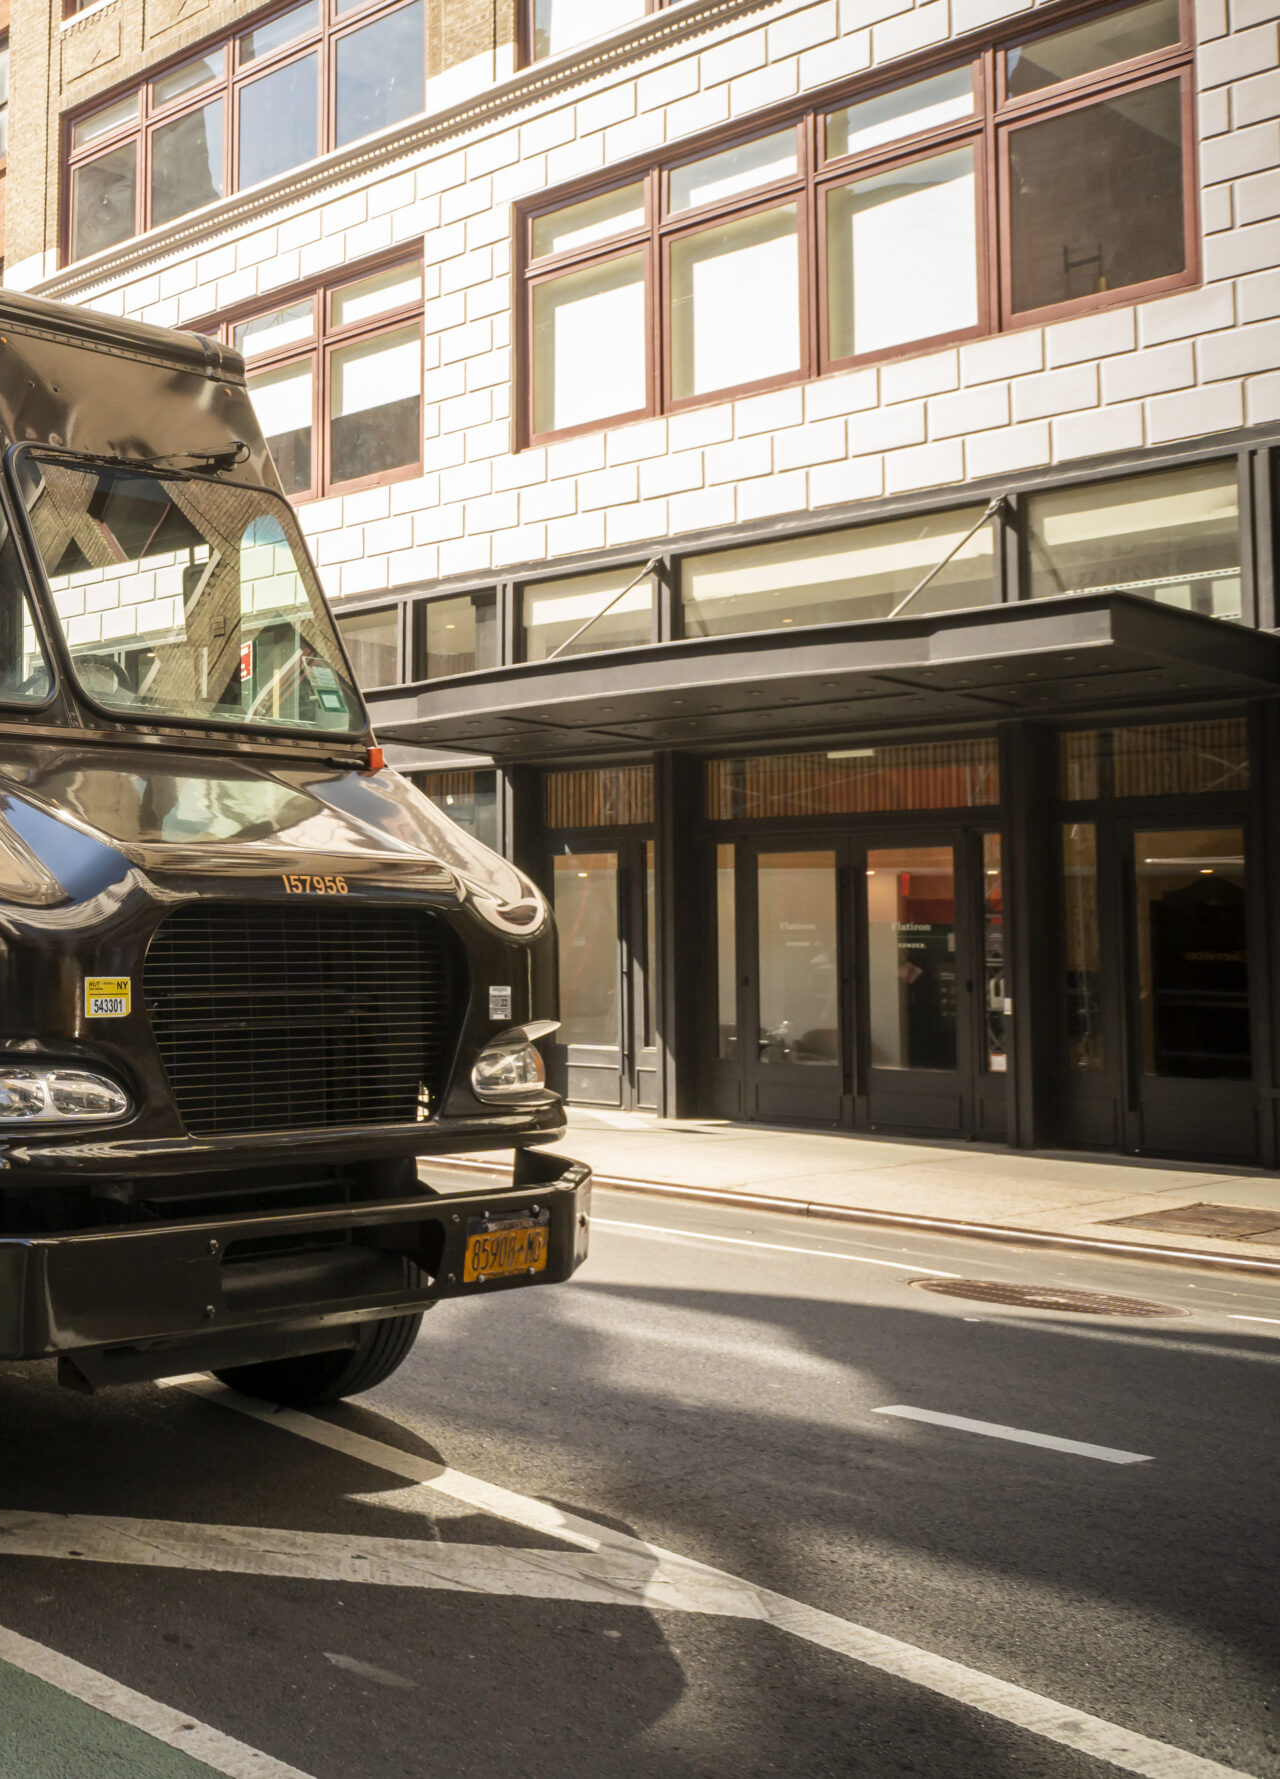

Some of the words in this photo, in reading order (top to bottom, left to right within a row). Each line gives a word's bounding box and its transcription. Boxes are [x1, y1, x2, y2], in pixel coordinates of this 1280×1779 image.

[282, 874, 349, 895] 157956
[890, 921, 932, 931] Flatiron
[116, 981, 129, 990] NY
[94, 998, 123, 1013] 543301
